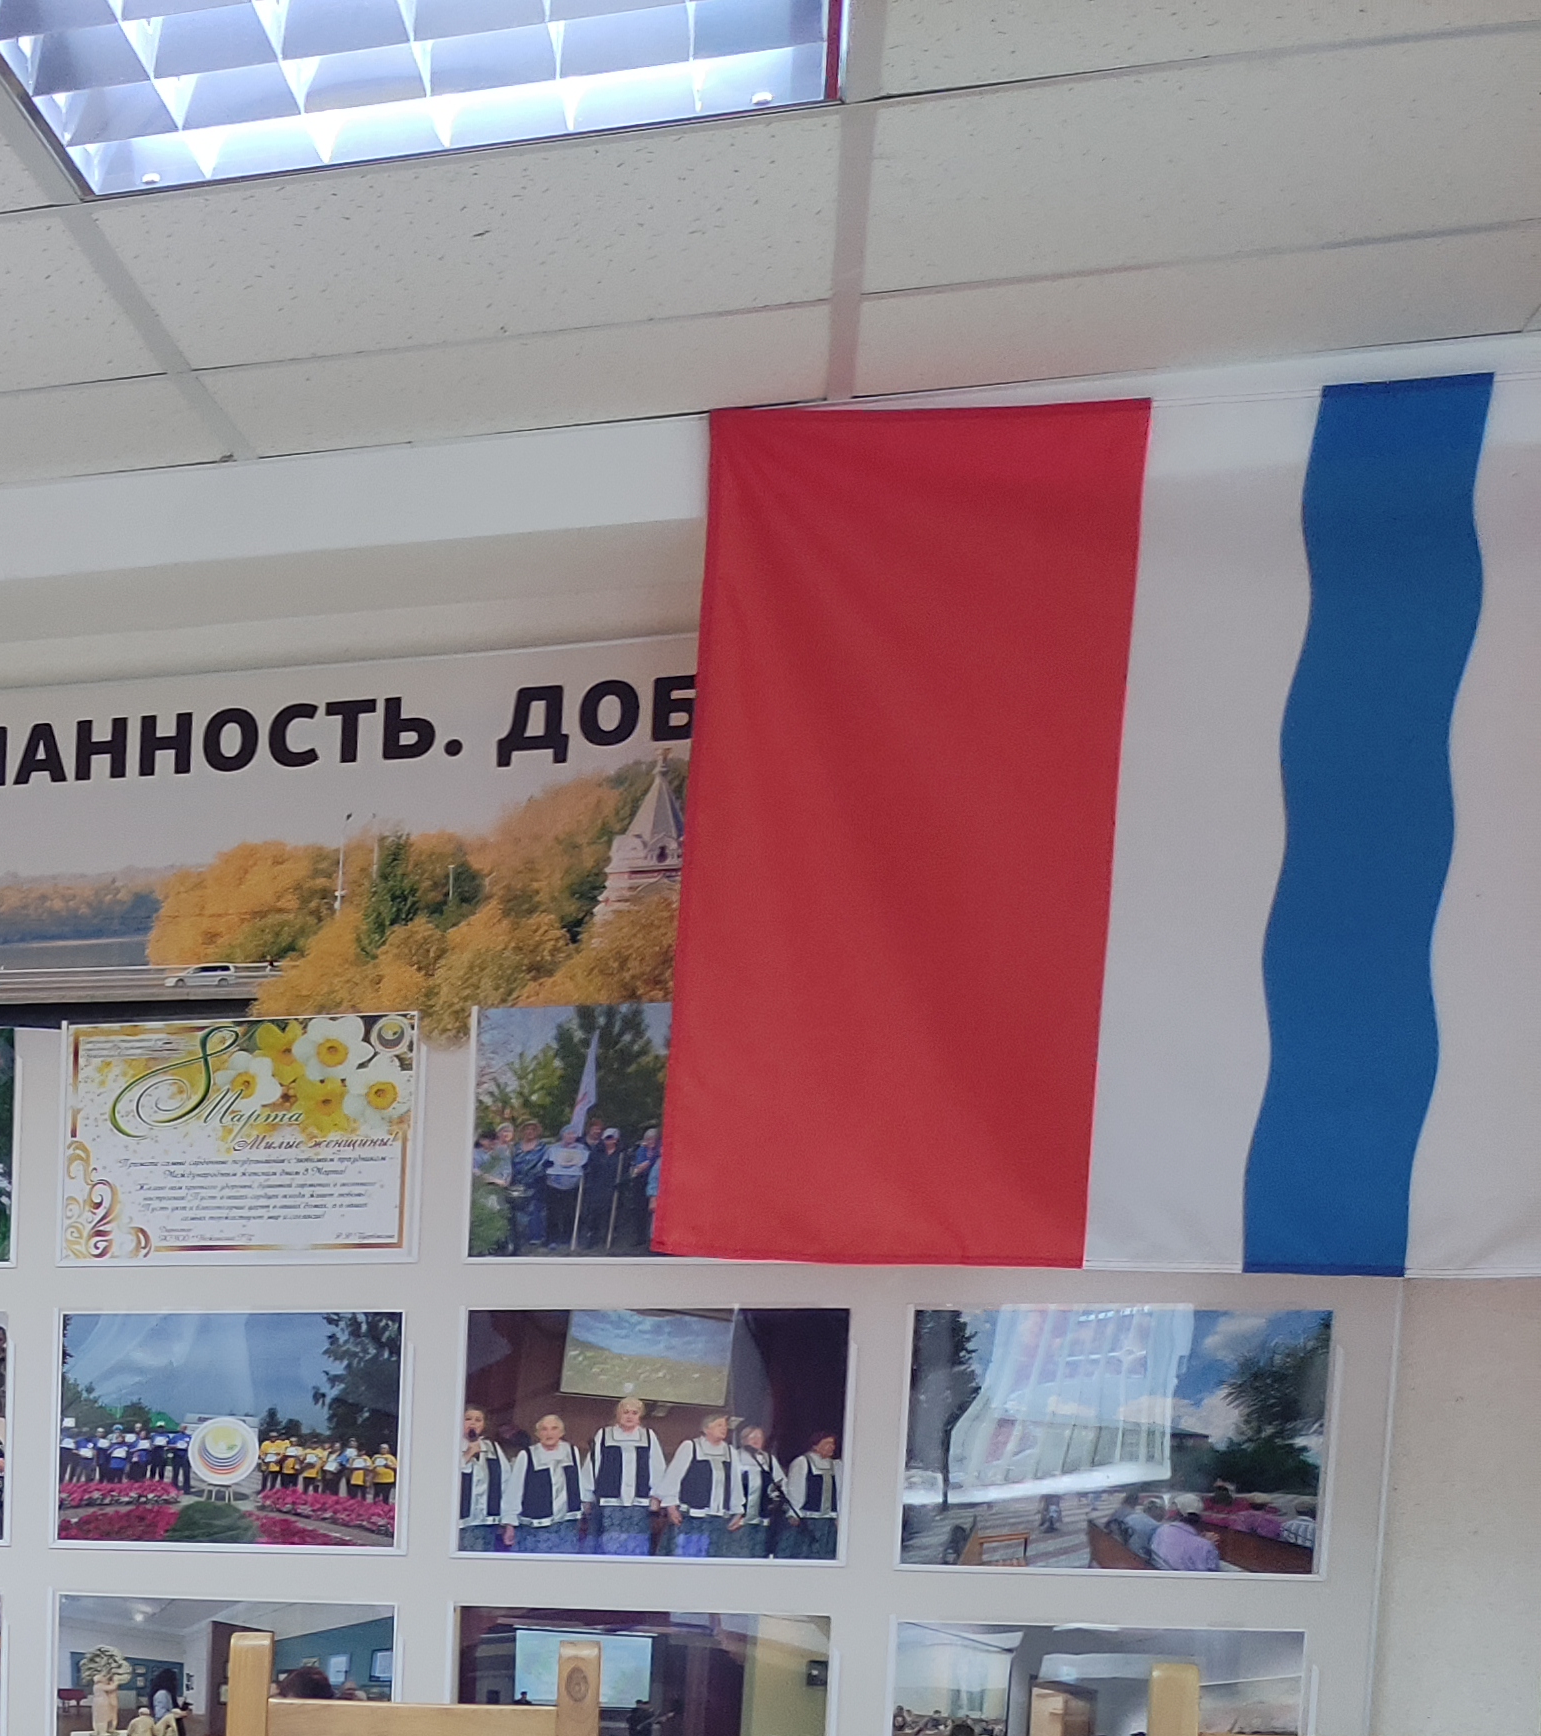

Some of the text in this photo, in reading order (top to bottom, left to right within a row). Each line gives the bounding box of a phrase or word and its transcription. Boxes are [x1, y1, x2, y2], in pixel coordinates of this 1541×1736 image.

[200, 1086, 304, 1143] Марта
[233, 1131, 400, 1151] Милые женщины!
